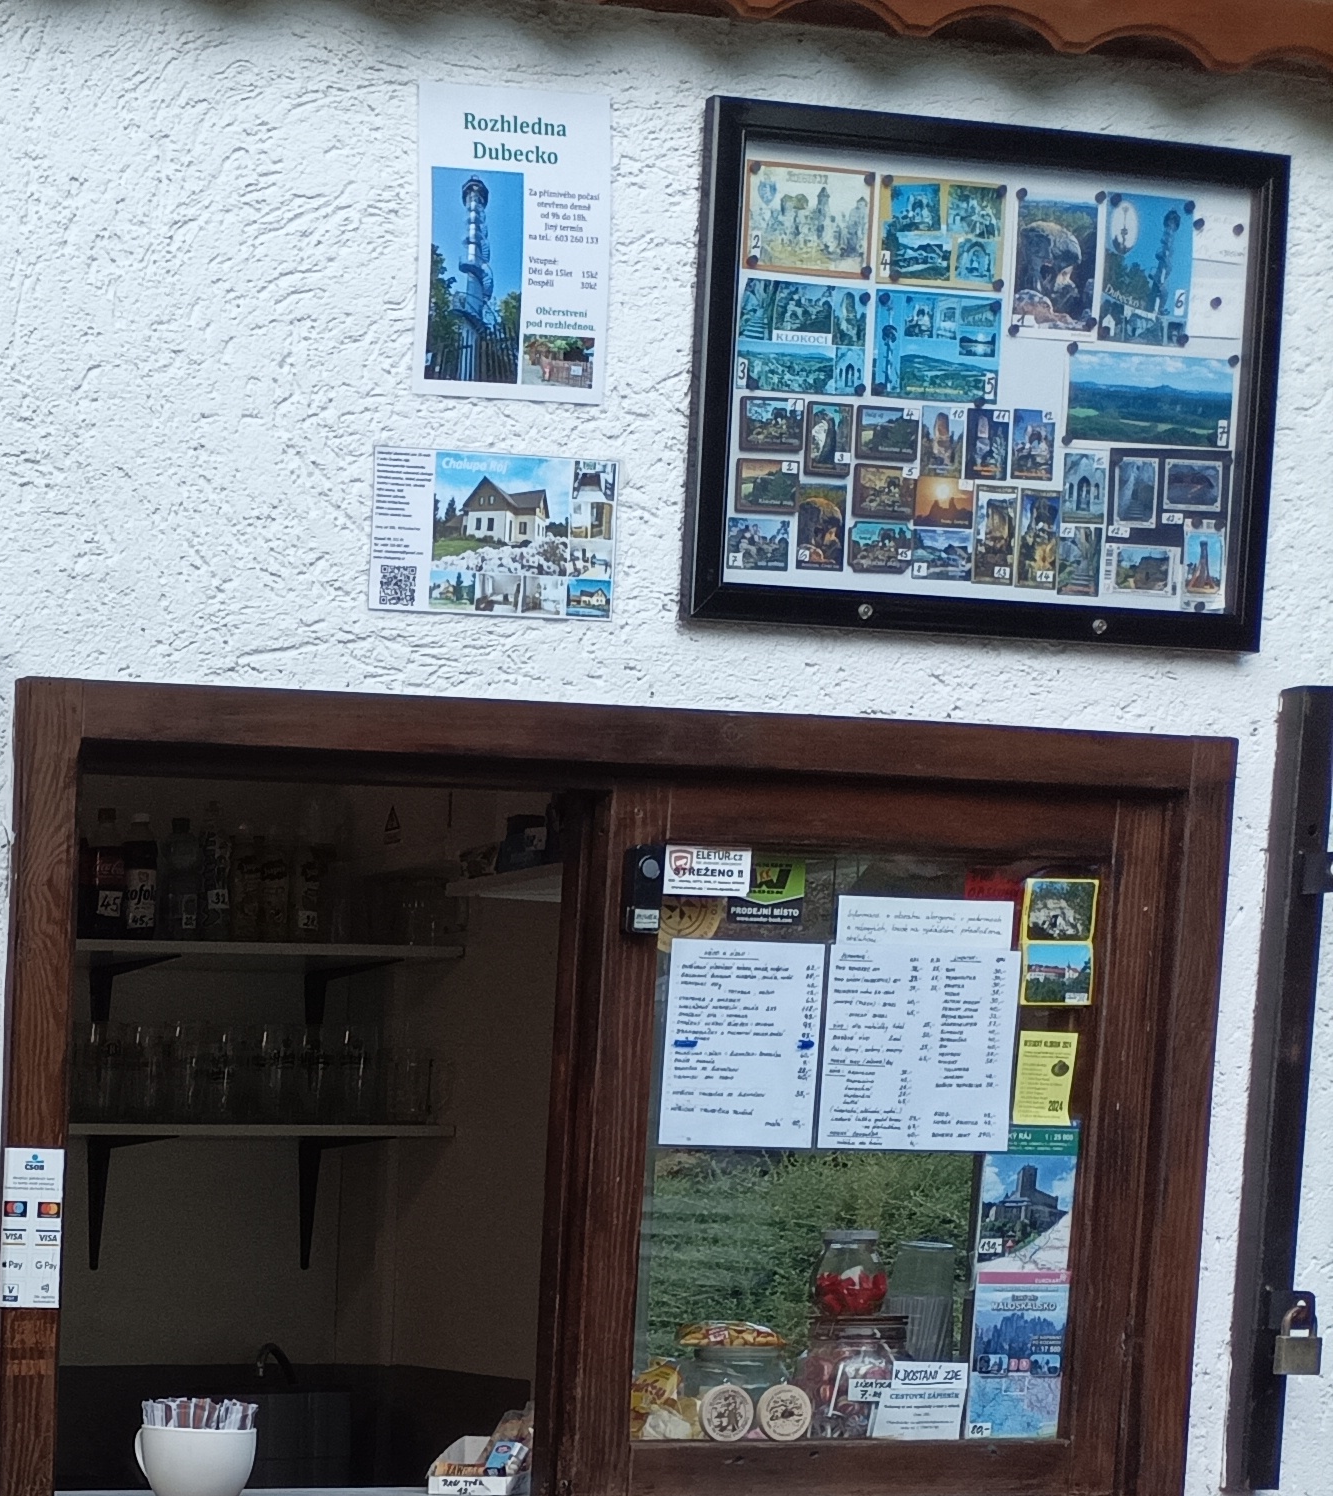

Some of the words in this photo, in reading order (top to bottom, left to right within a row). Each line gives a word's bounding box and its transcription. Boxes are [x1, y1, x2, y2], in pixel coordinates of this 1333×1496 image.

[463, 112, 567, 137] Rozhledna
[473, 141, 559, 165] Dubecko
[570, 235, 583, 243] 260
[753, 235, 760, 250] 2
[880, 252, 890, 270] 4
[1174, 292, 1185, 309] 6
[526, 320, 542, 329] pod
[738, 361, 747, 380] 3
[984, 376, 995, 395] 5
[951, 408, 965, 418] 10
[1044, 410, 1054, 420] 12
[442, 457, 487, 473] Chalupa
[100, 896, 119, 912] 45
[731, 906, 772, 916] PRODEJNÍ
[773, 907, 800, 917] MÍSTO
[1048, 1101, 1063, 1112] 2024
[1019, 1131, 1032, 1140] RÁJ
[4, 1233, 23, 1241] VISA
[38, 1234, 58, 1242] VISA
[8, 1261, 23, 1270] Pay
[35, 1261, 43, 1270] G
[44, 1262, 57, 1271] Pay
[901, 1365, 939, 1381] DOSTÁNÍ
[943, 1369, 962, 1381] ZDE
